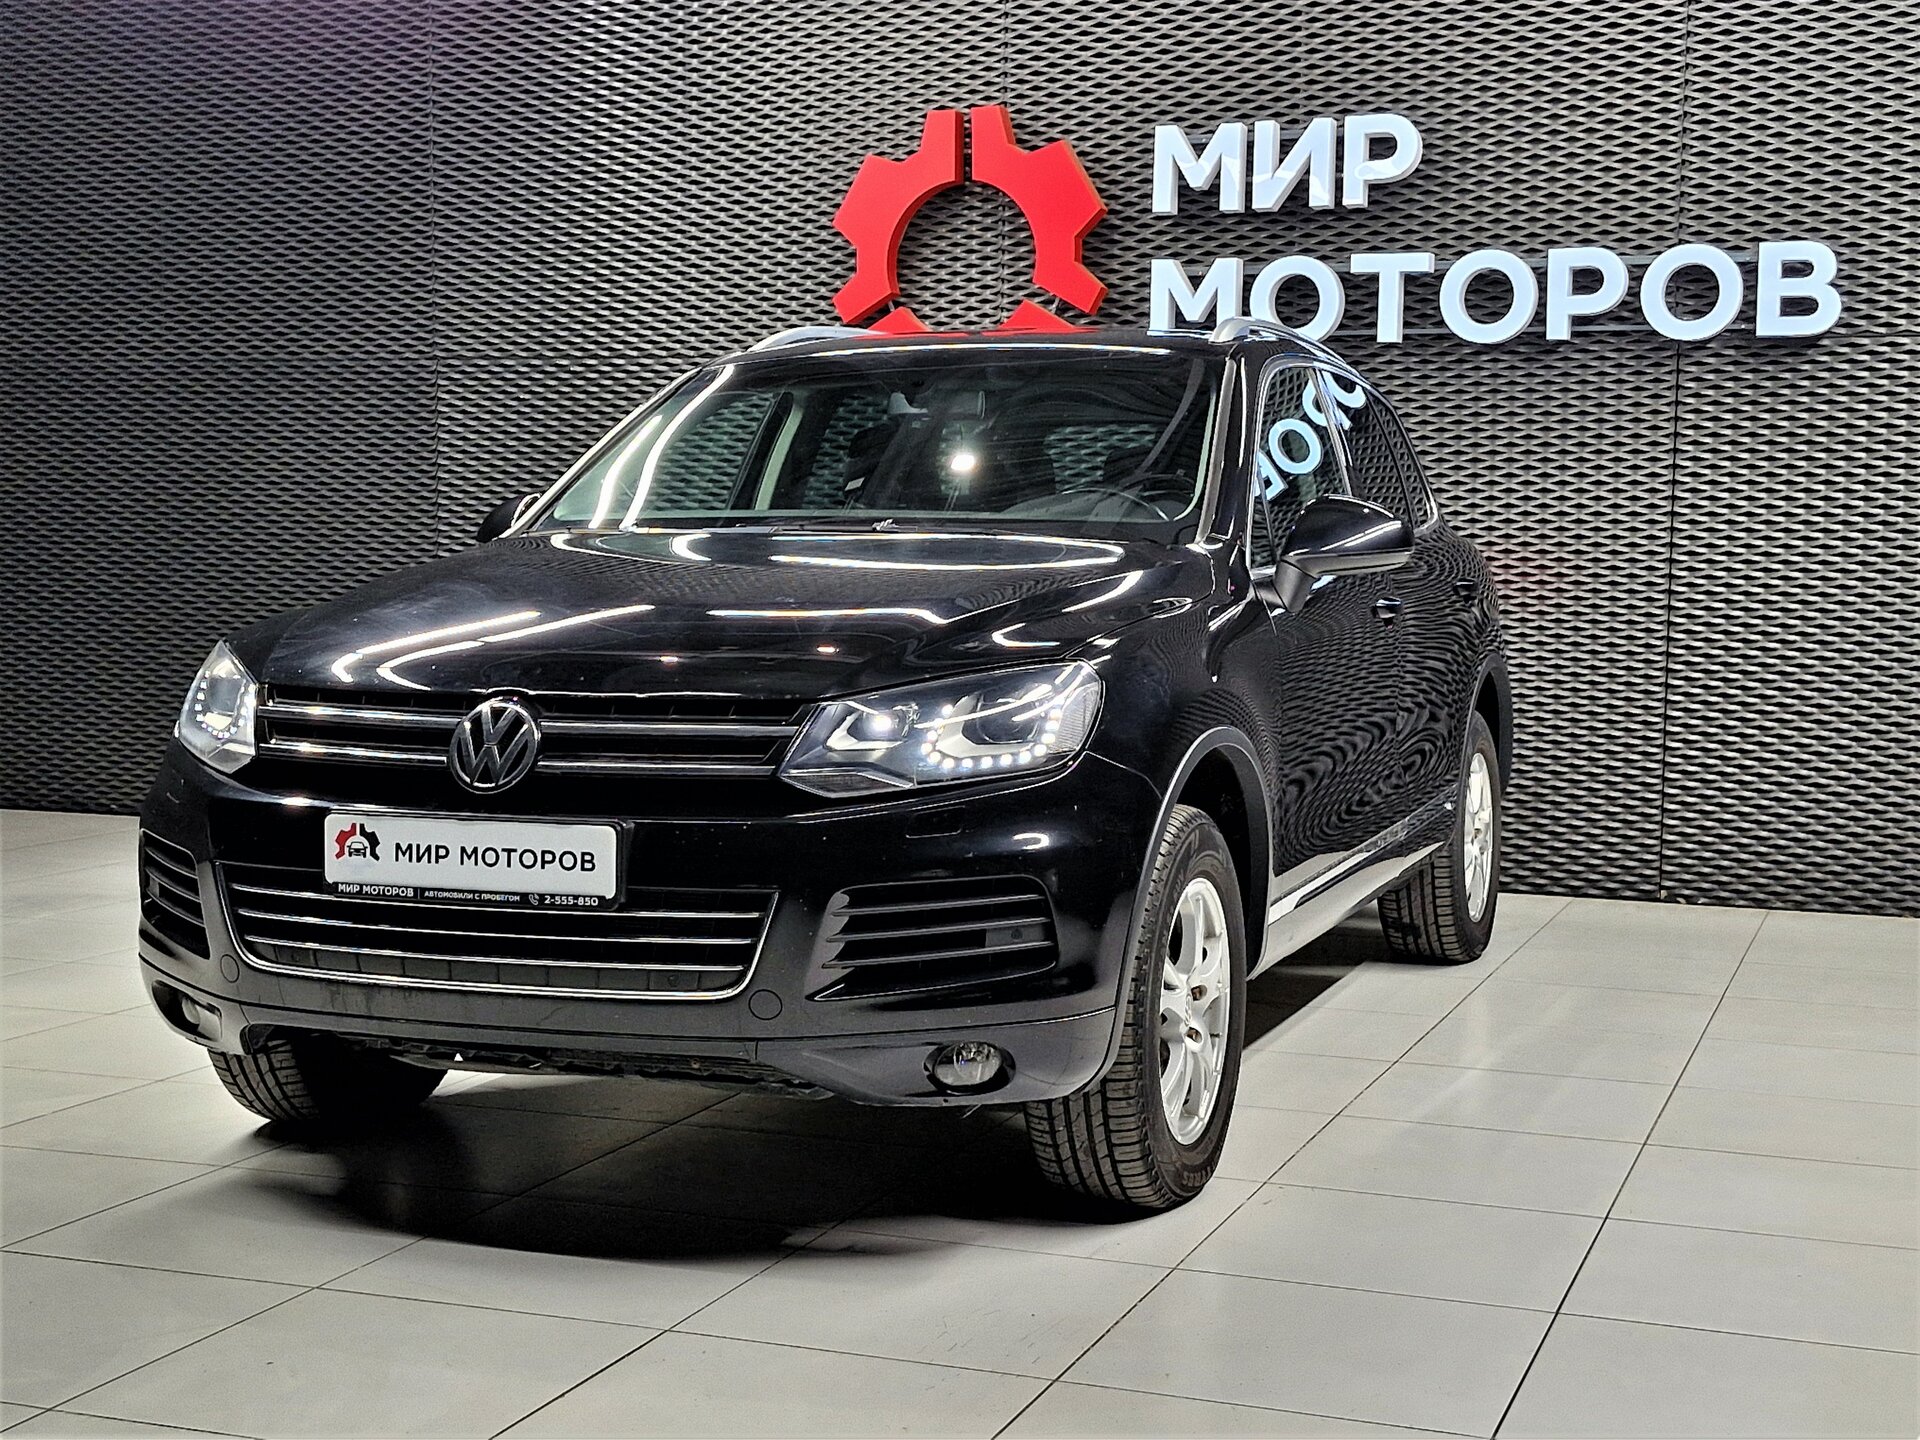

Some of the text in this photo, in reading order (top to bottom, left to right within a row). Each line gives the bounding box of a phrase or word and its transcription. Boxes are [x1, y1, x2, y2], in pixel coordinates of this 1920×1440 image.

[1151, 114, 1423, 216] МИР
[1147, 240, 1842, 343] МОТОРОВ
[394, 842, 597, 872] МИР МОТОРОВ
[338, 883, 360, 894] МИР
[362, 884, 414, 897] МОТОРОВ
[544, 895, 599, 906] 2-555-850
